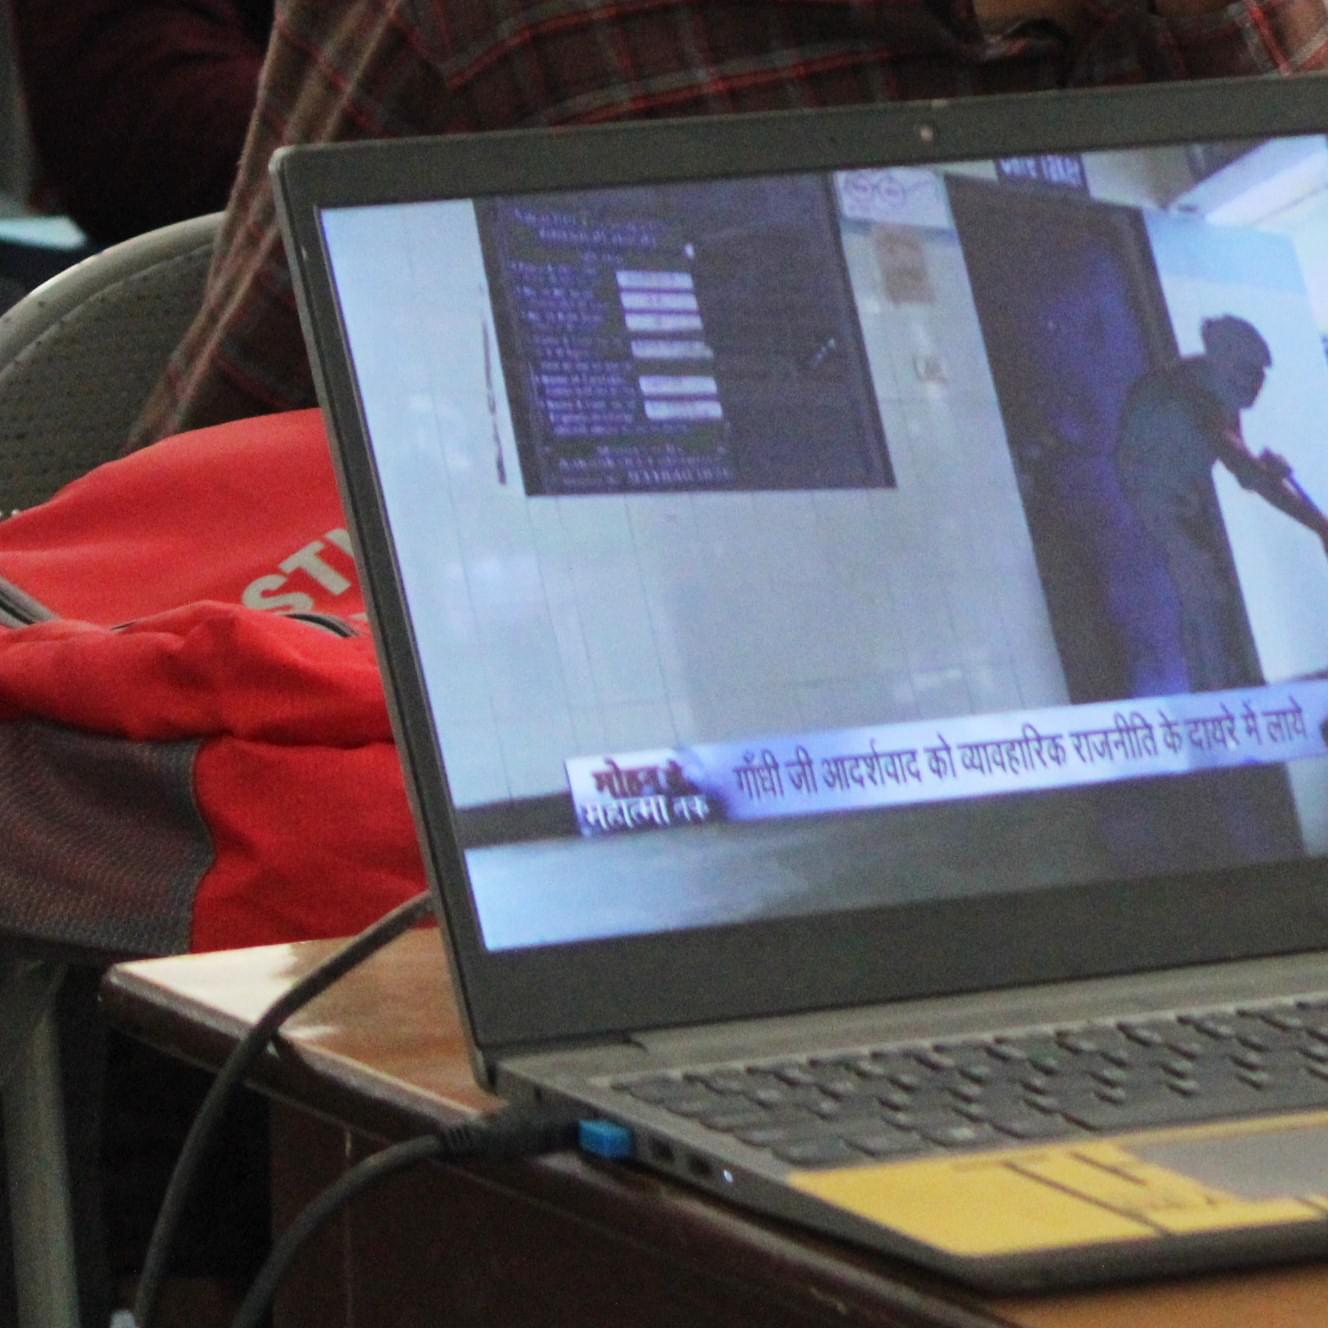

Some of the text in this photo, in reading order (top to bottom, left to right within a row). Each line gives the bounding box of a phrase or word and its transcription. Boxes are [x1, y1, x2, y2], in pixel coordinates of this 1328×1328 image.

[785, 744, 818, 793] जी
[822, 738, 922, 792] आदर्शवाद
[924, 731, 958, 781] को
[958, 722, 1066, 777] व्यावहारिक
[1068, 709, 1159, 763] राजनीति
[1159, 709, 1184, 754] के
[1184, 702, 1240, 751] दायरे
[1241, 698, 1262, 745] में
[1261, 696, 1307, 744] लाये
